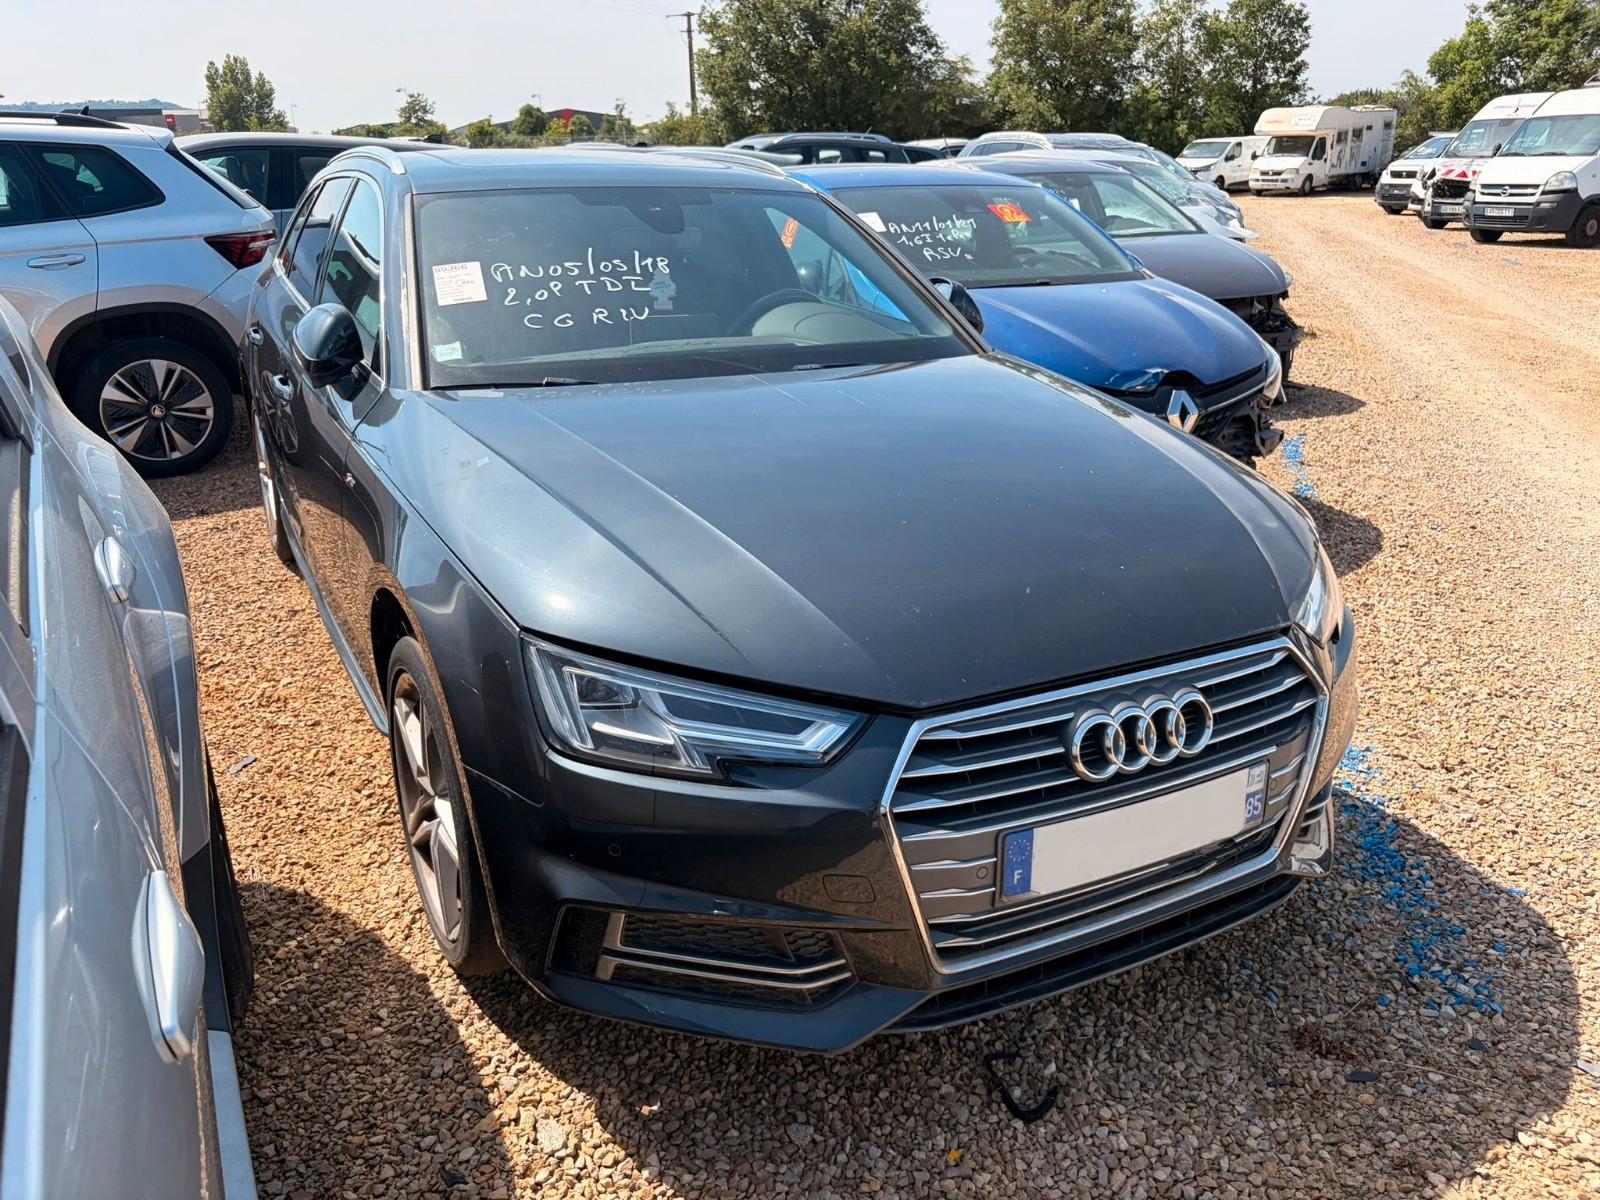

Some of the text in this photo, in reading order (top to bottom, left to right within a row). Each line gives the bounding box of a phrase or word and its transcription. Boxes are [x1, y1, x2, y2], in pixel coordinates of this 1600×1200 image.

[575, 277, 651, 295] TDI
[1246, 793, 1263, 818] 85
[1013, 869, 1023, 885] F
